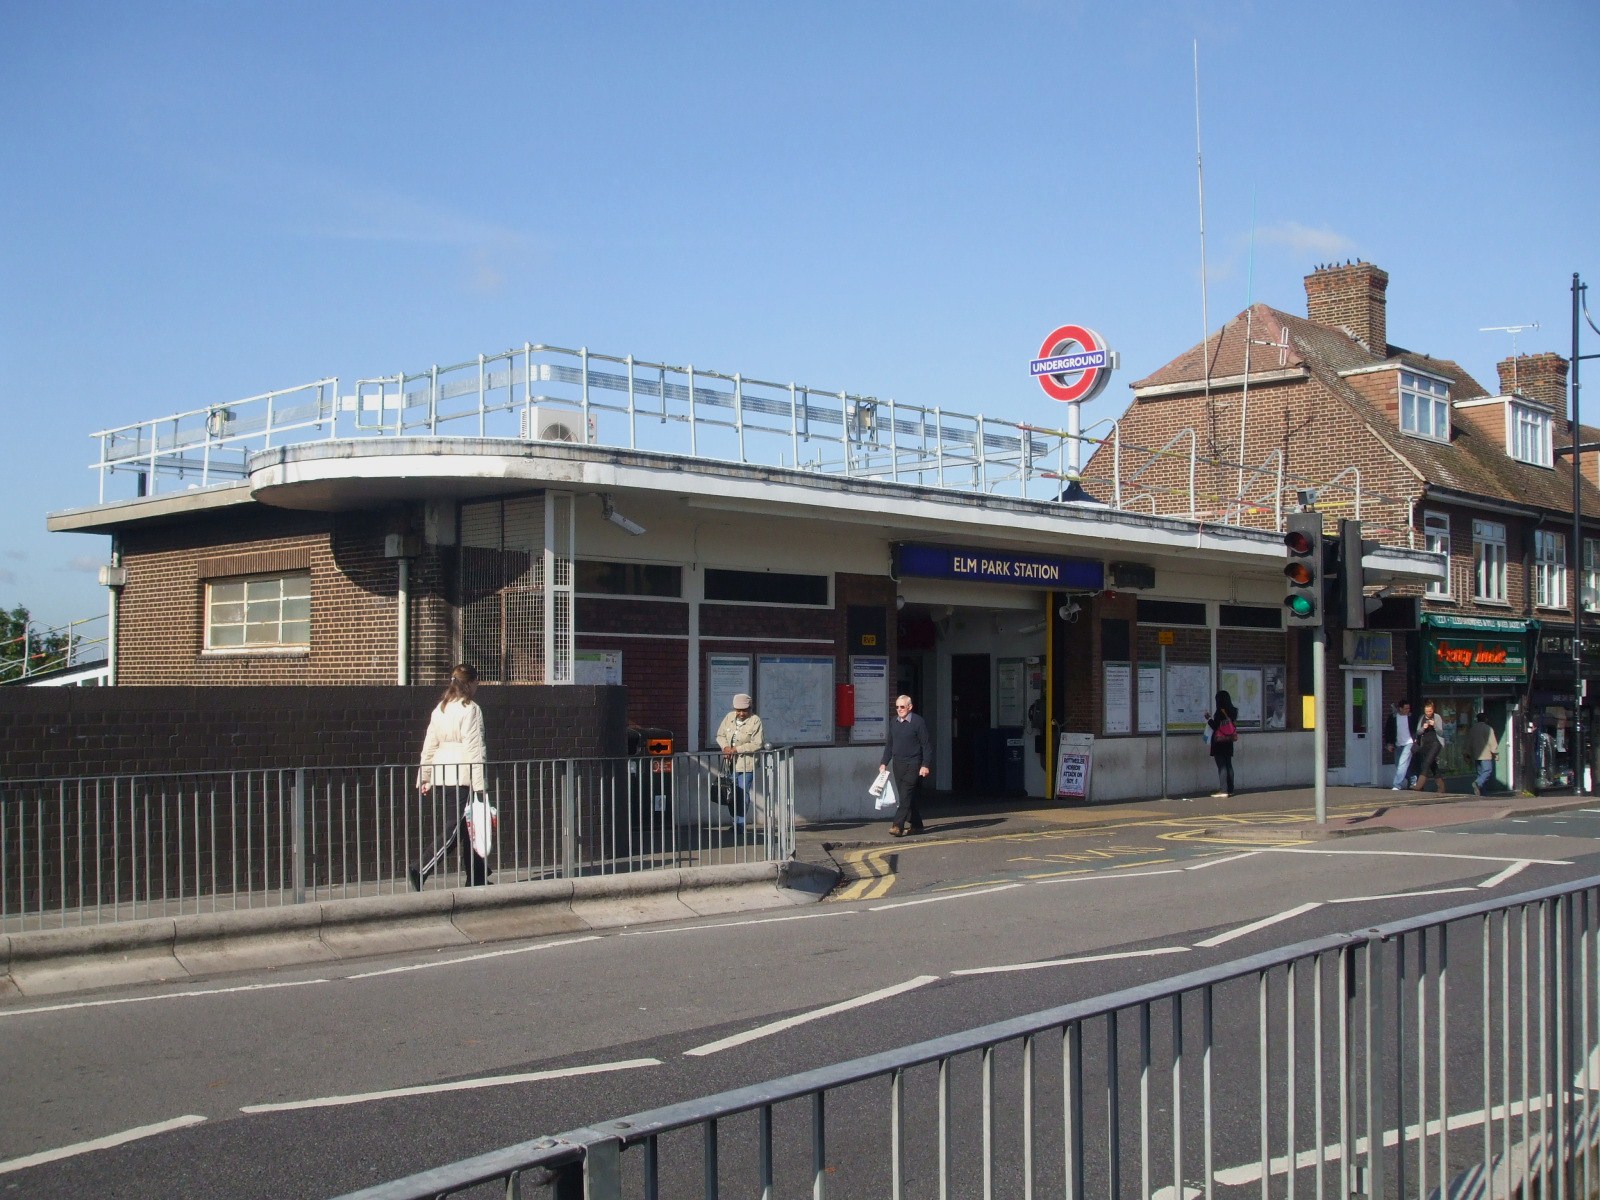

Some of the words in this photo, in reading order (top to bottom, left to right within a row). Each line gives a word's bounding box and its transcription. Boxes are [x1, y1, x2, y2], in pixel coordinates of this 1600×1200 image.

[1032, 354, 1103, 373] UNDERGROUND
[953, 556, 977, 574] ELM
[981, 559, 1011, 576] PARK
[1013, 562, 1059, 580] STATION
